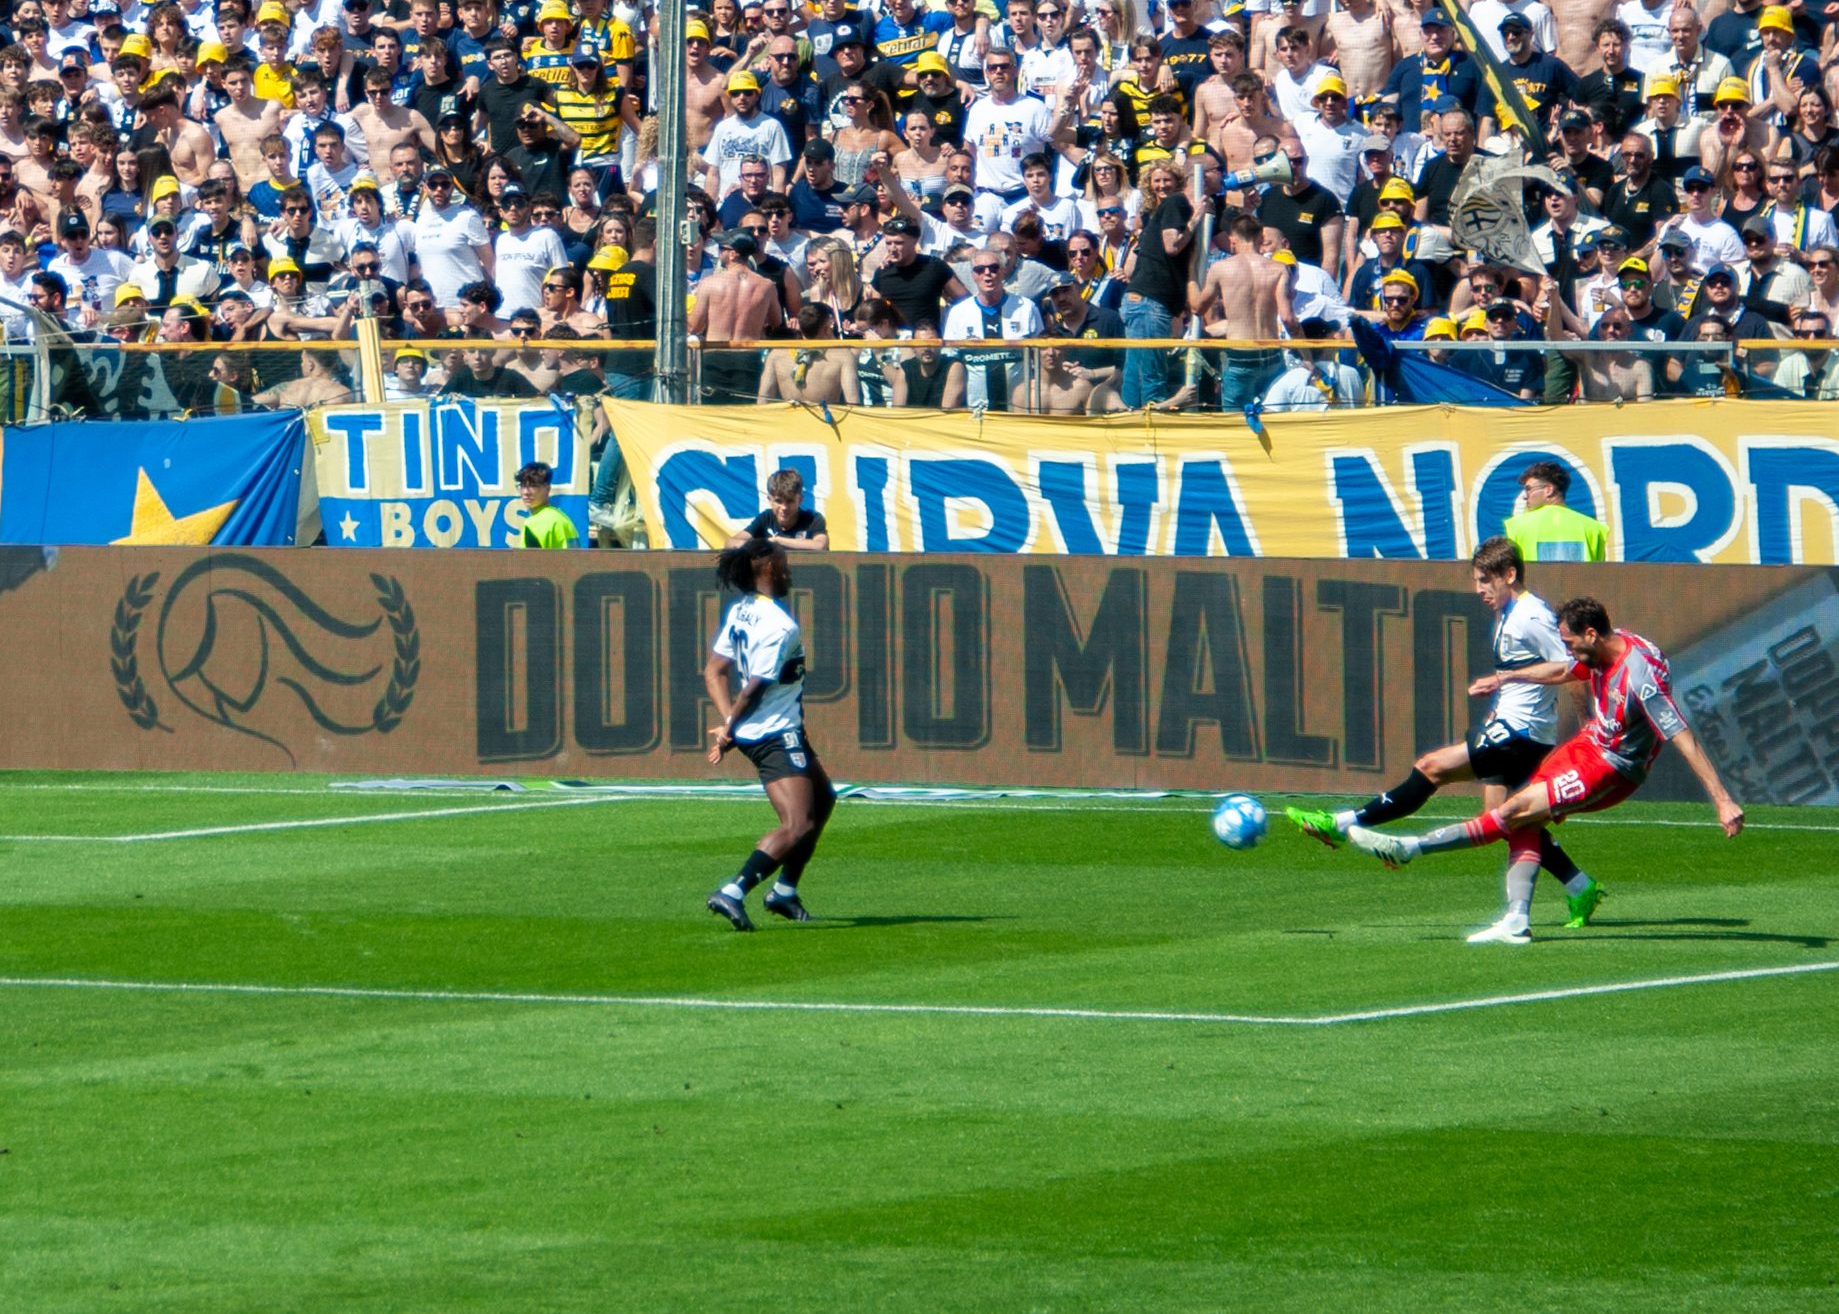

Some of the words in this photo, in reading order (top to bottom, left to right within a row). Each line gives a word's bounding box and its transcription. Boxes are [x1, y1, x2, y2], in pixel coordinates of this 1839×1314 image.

[323, 404, 580, 494] TINO
[380, 499, 529, 548] BOYS
[476, 562, 991, 764] DOPPIO
[1556, 769, 1587, 800] 20
